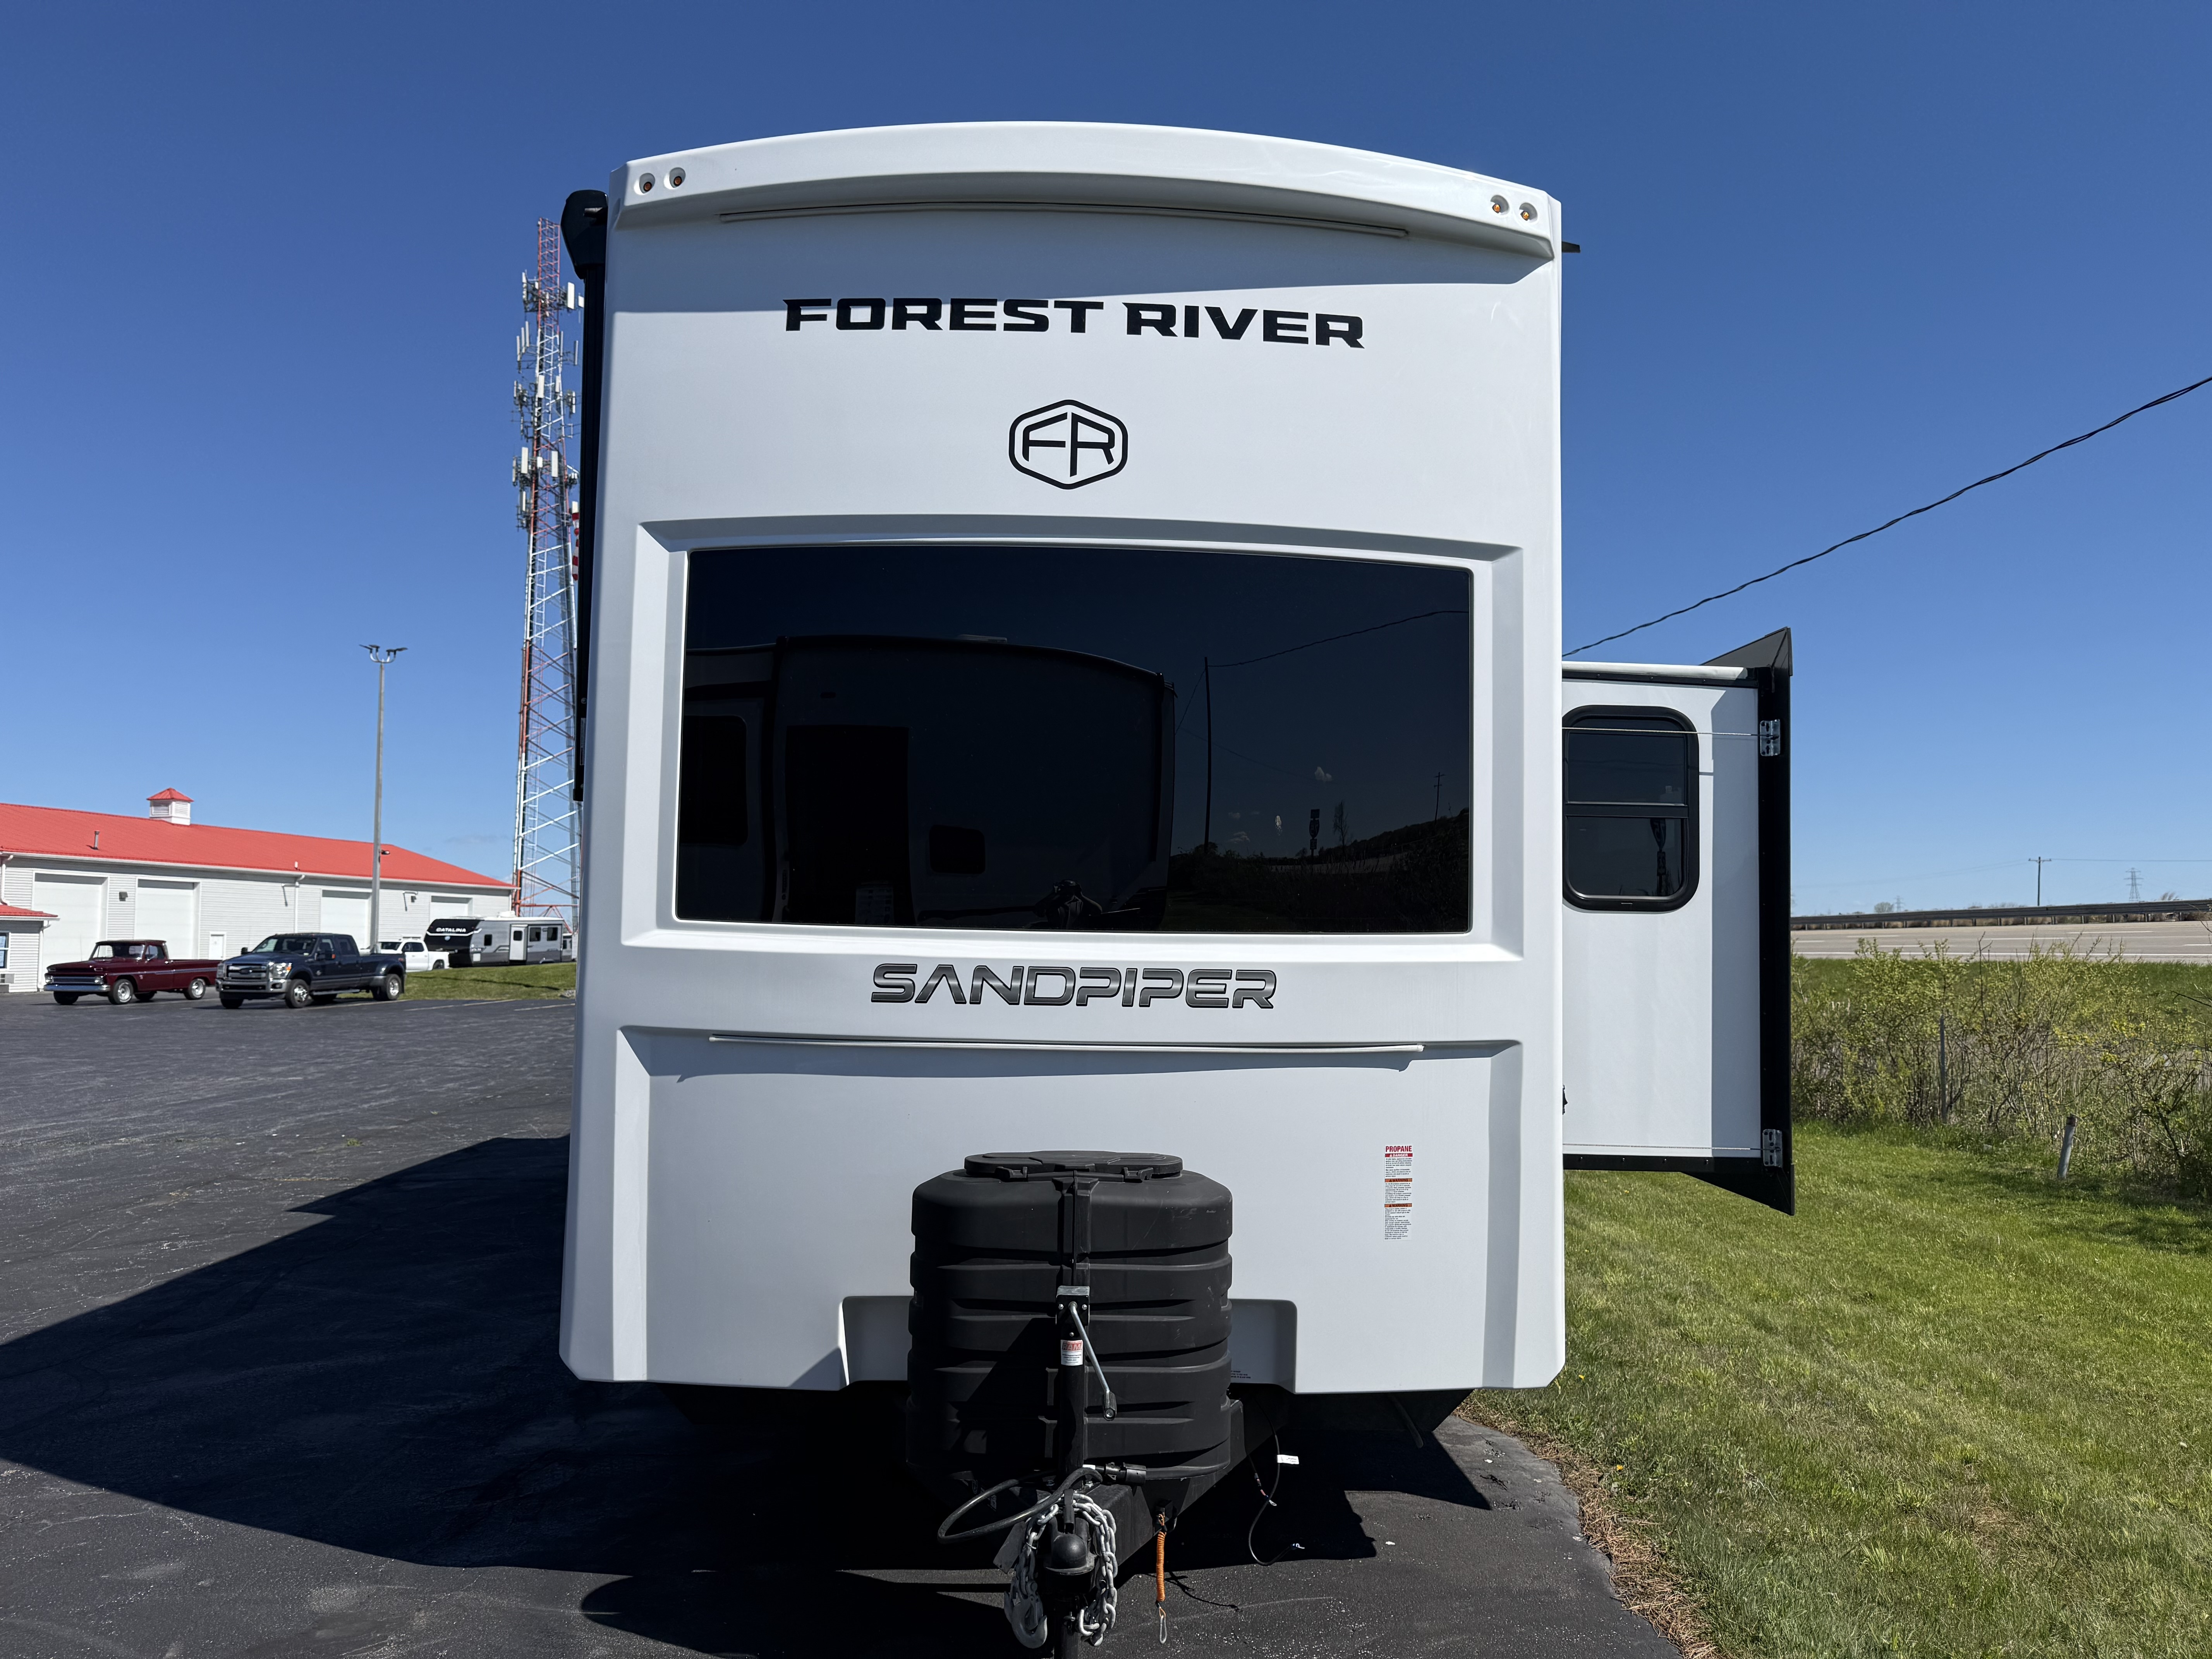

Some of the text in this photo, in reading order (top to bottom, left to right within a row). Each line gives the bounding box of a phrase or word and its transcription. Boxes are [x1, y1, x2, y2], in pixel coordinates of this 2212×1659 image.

[783, 298, 1364, 348] FOREST RIVER
[1022, 412, 1115, 477] FR
[871, 963, 1276, 1008] SANDPIPER
